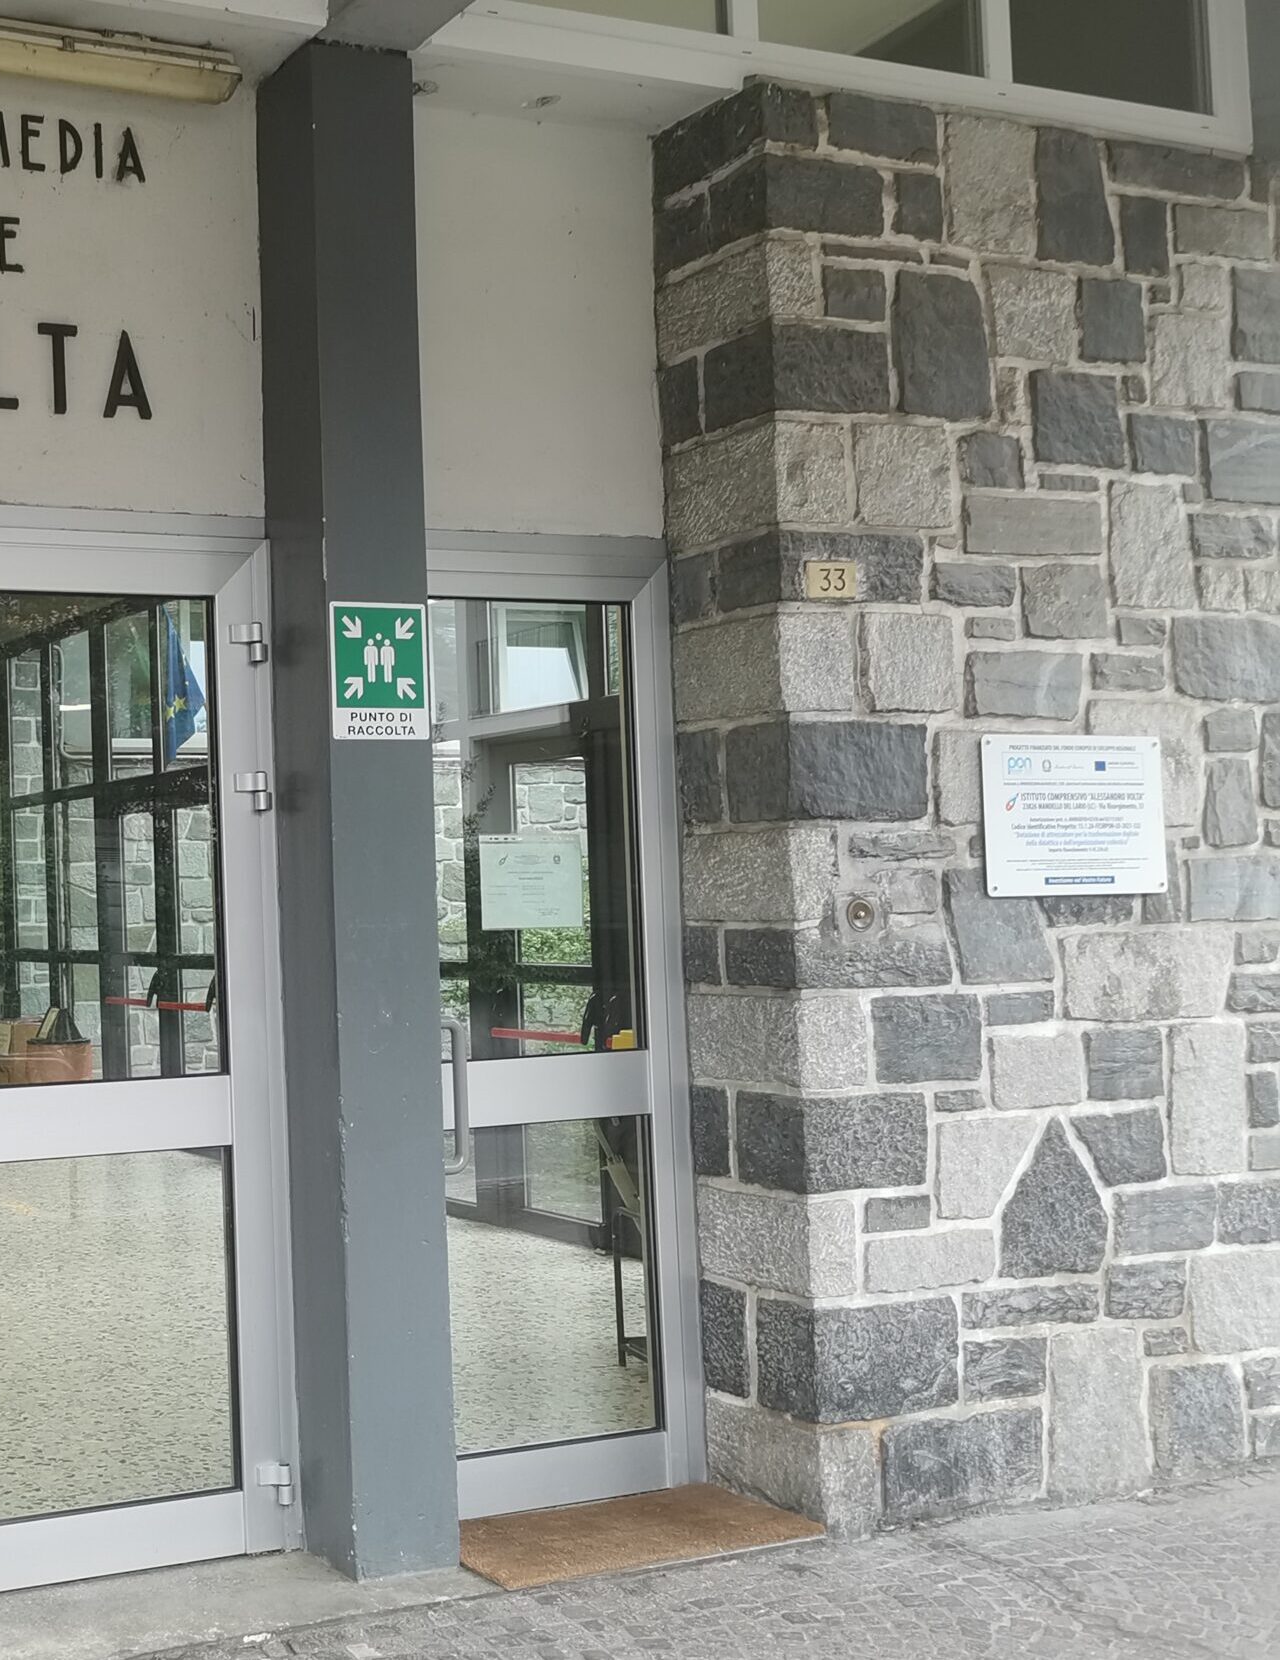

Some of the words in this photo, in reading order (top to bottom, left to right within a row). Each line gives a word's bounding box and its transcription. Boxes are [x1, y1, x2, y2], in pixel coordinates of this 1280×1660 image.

[819, 568, 846, 592] 33
[350, 712, 395, 722] PUNTO
[400, 712, 412, 722] DI
[347, 725, 416, 736] RACCOLTA
[1021, 792, 1047, 801] ISTITUTO
[1047, 792, 1087, 801] COMPRENSIVO
